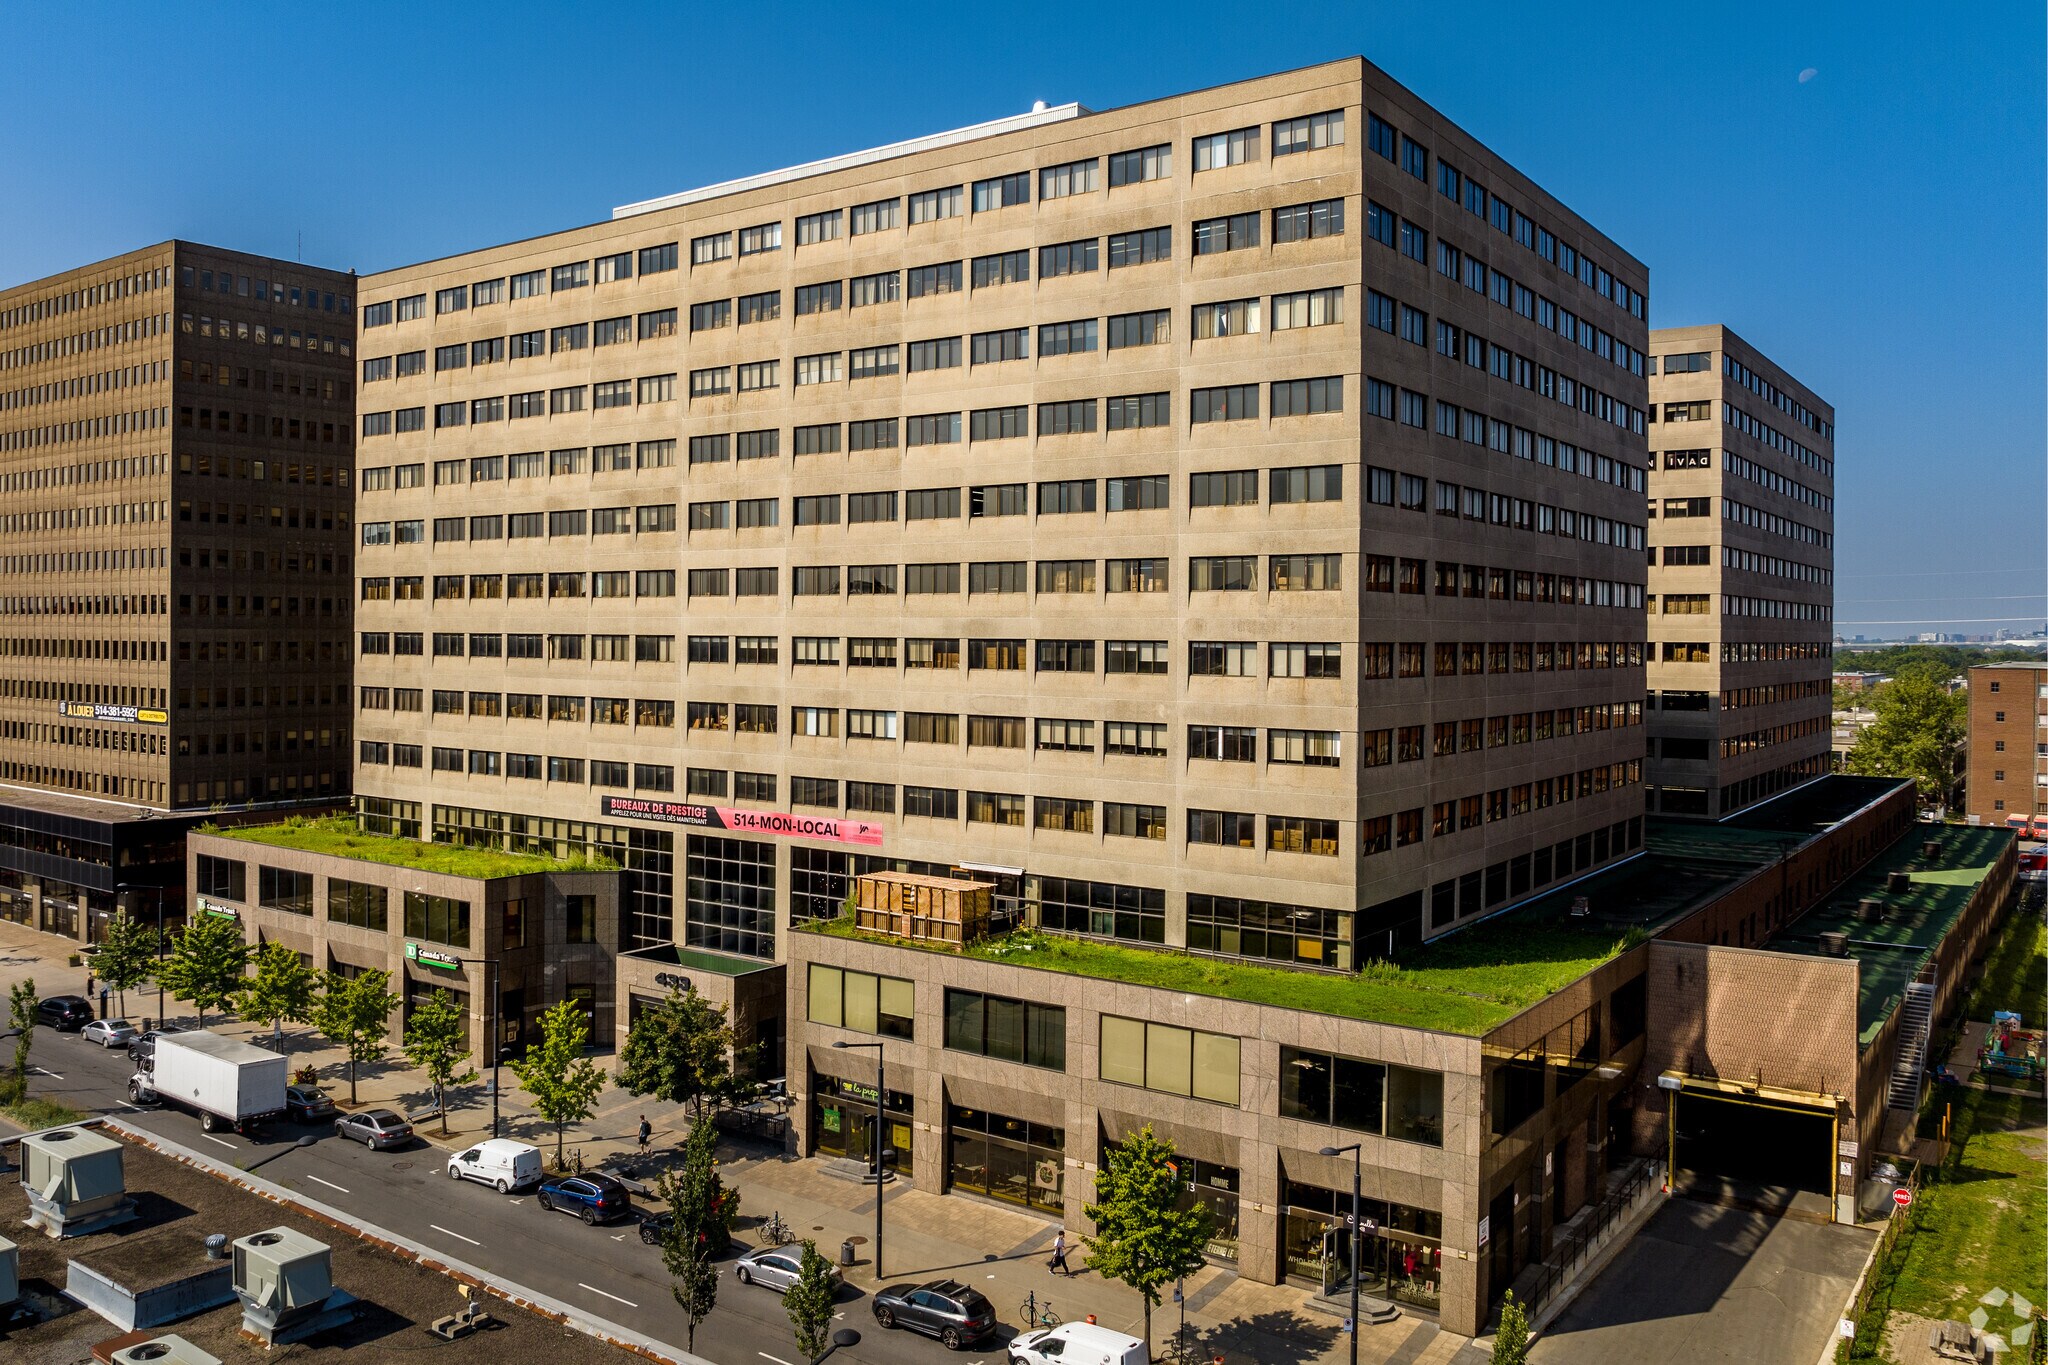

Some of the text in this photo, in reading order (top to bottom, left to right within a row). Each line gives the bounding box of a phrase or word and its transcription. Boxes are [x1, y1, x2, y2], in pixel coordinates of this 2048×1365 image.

[73, 704, 95, 718] LOUER
[95, 705, 138, 717] 514-381-5921
[611, 799, 707, 818] BUREAUX DE PRESTIGE
[666, 814, 676, 822] DÈS
[676, 816, 707, 825] MAINTENANT
[734, 813, 841, 837] 514-MON-LOCAL
[407, 946, 415, 956] TD
[418, 949, 440, 960] Canada
